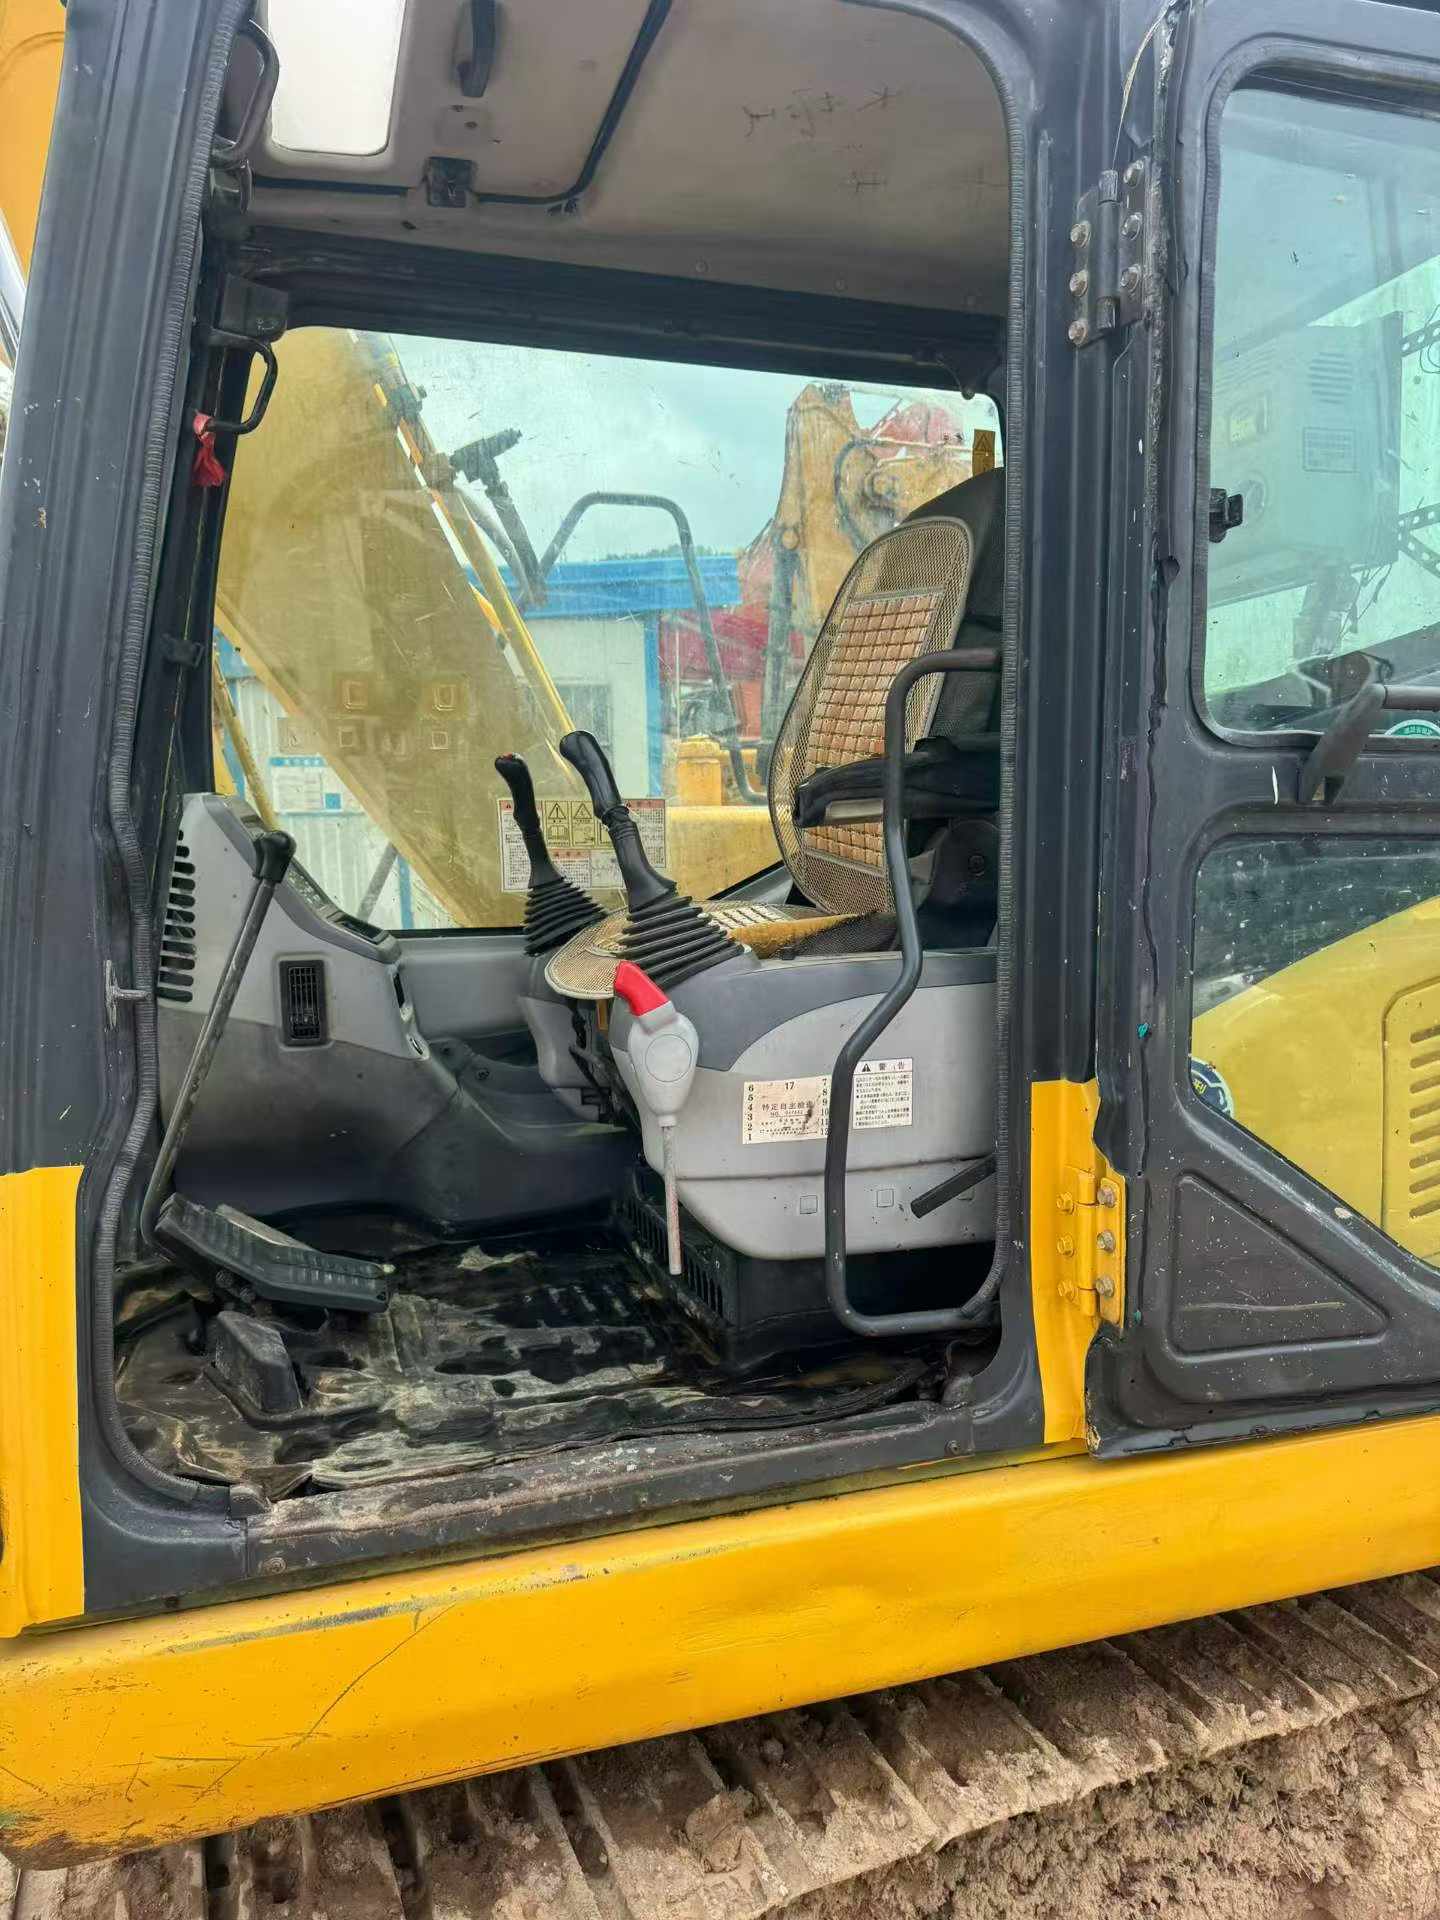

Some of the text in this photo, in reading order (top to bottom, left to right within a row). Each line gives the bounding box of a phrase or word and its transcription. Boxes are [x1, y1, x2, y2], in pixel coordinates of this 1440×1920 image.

[785, 1081, 795, 1090] 17
[822, 1078, 828, 1086] 7
[748, 1084, 754, 1092] 6
[822, 1088, 828, 1096] 8
[747, 1094, 754, 1102] 5
[822, 1098, 828, 1106] 9
[747, 1103, 753, 1111] 4
[820, 1108, 829, 1117] 10
[747, 1113, 753, 1121] 3
[747, 1123, 753, 1131] 2
[748, 1133, 752, 1141] 1
